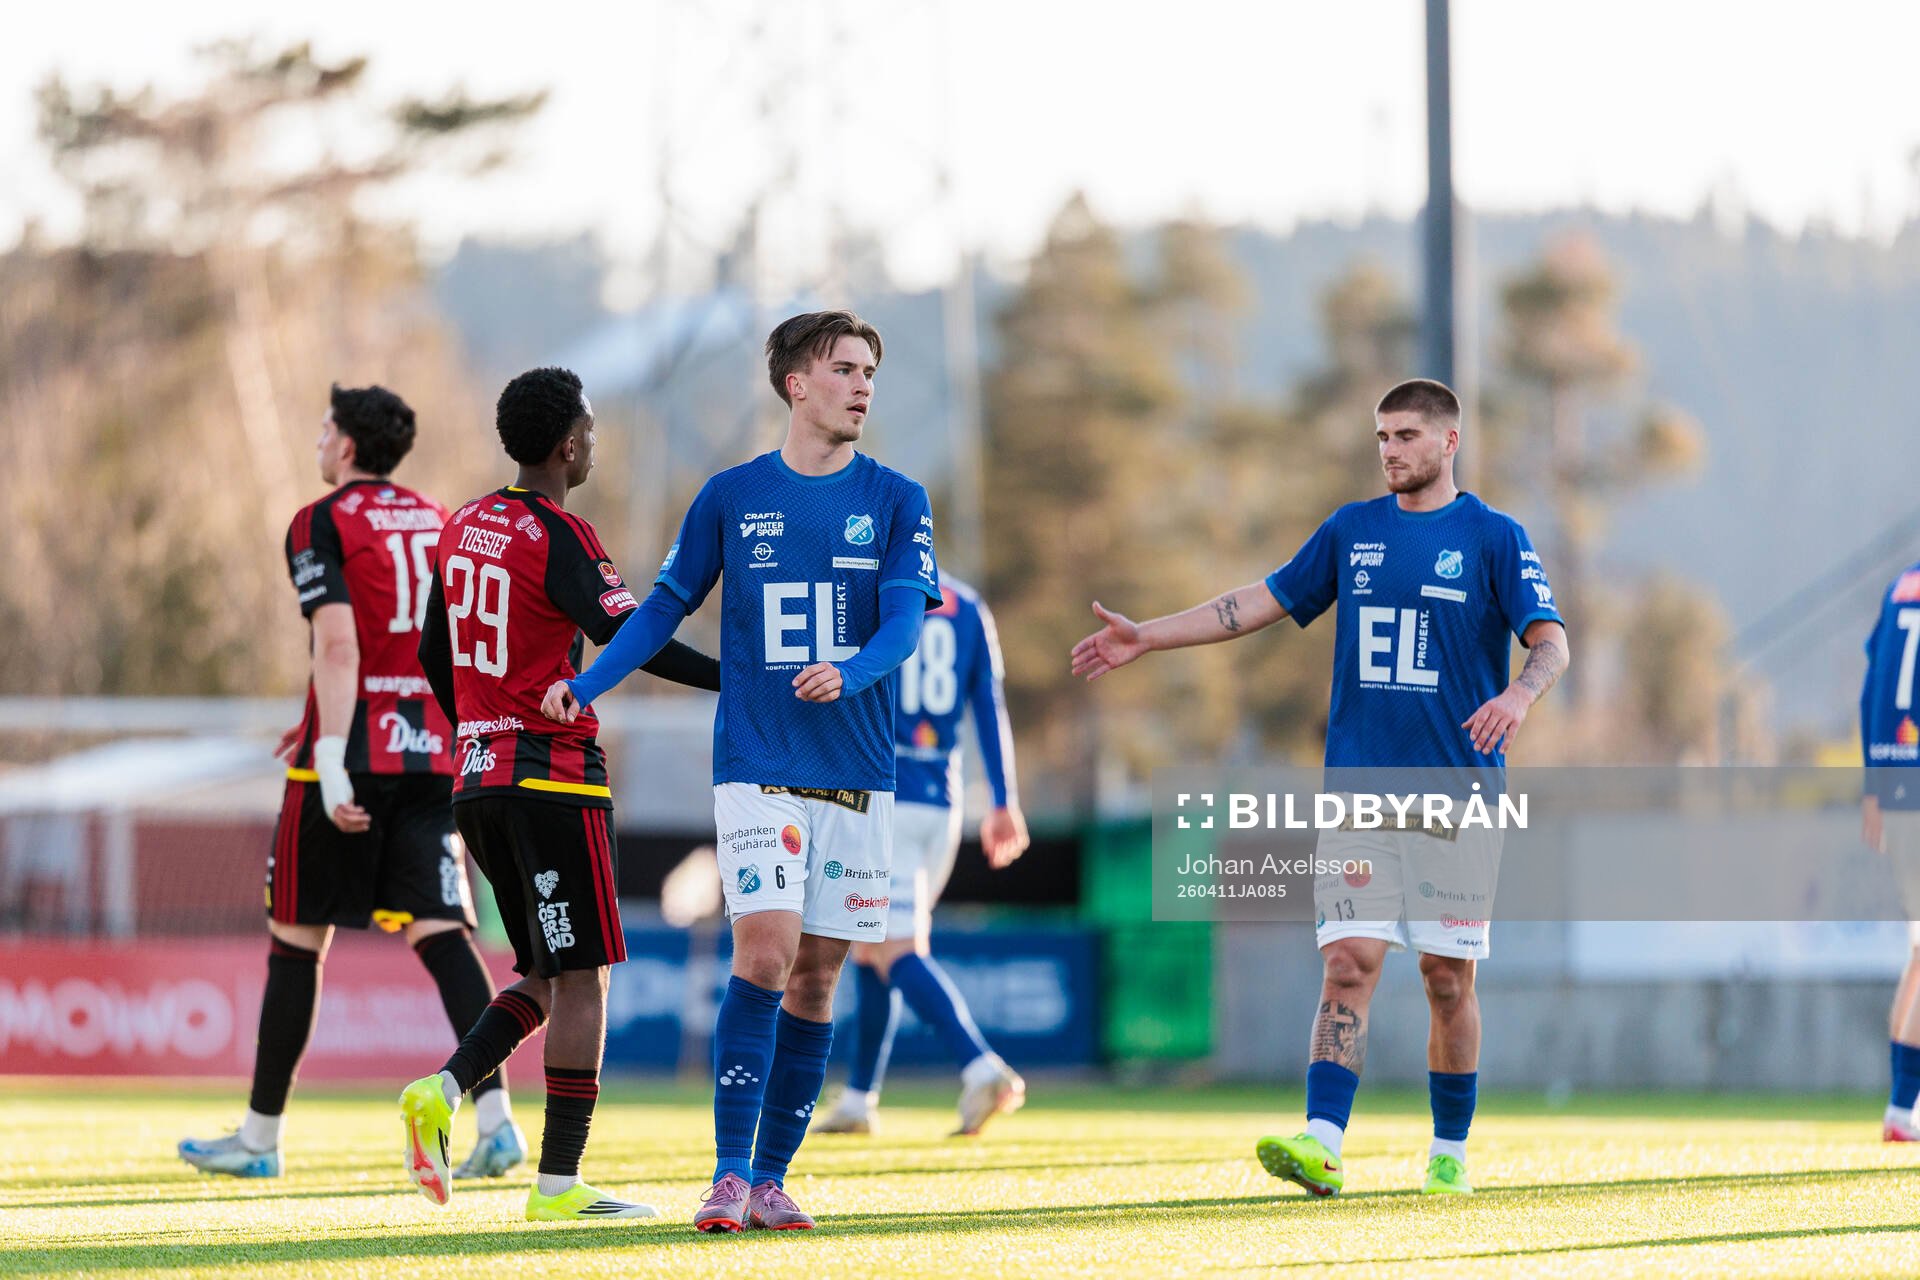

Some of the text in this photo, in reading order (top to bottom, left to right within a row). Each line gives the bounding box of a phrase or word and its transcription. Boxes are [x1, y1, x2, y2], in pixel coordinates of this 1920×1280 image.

[458, 525, 512, 559] YOSSIEF
[757, 521, 784, 529] INTER
[446, 554, 511, 678] 29
[764, 582, 860, 663] EL
[837, 582, 846, 643] PROJEKT.
[1359, 606, 1439, 686] EL
[1417, 610, 1430, 668] PROJEKT.
[901, 616, 957, 716] 18
[460, 738, 497, 776] Diös
[722, 826, 776, 844] Sparbanken
[732, 837, 777, 855] Sjuhärad
[775, 865, 786, 889] 6
[845, 868, 873, 879] Brink
[538, 901, 569, 924] ÖST
[1335, 898, 1355, 922] 13
